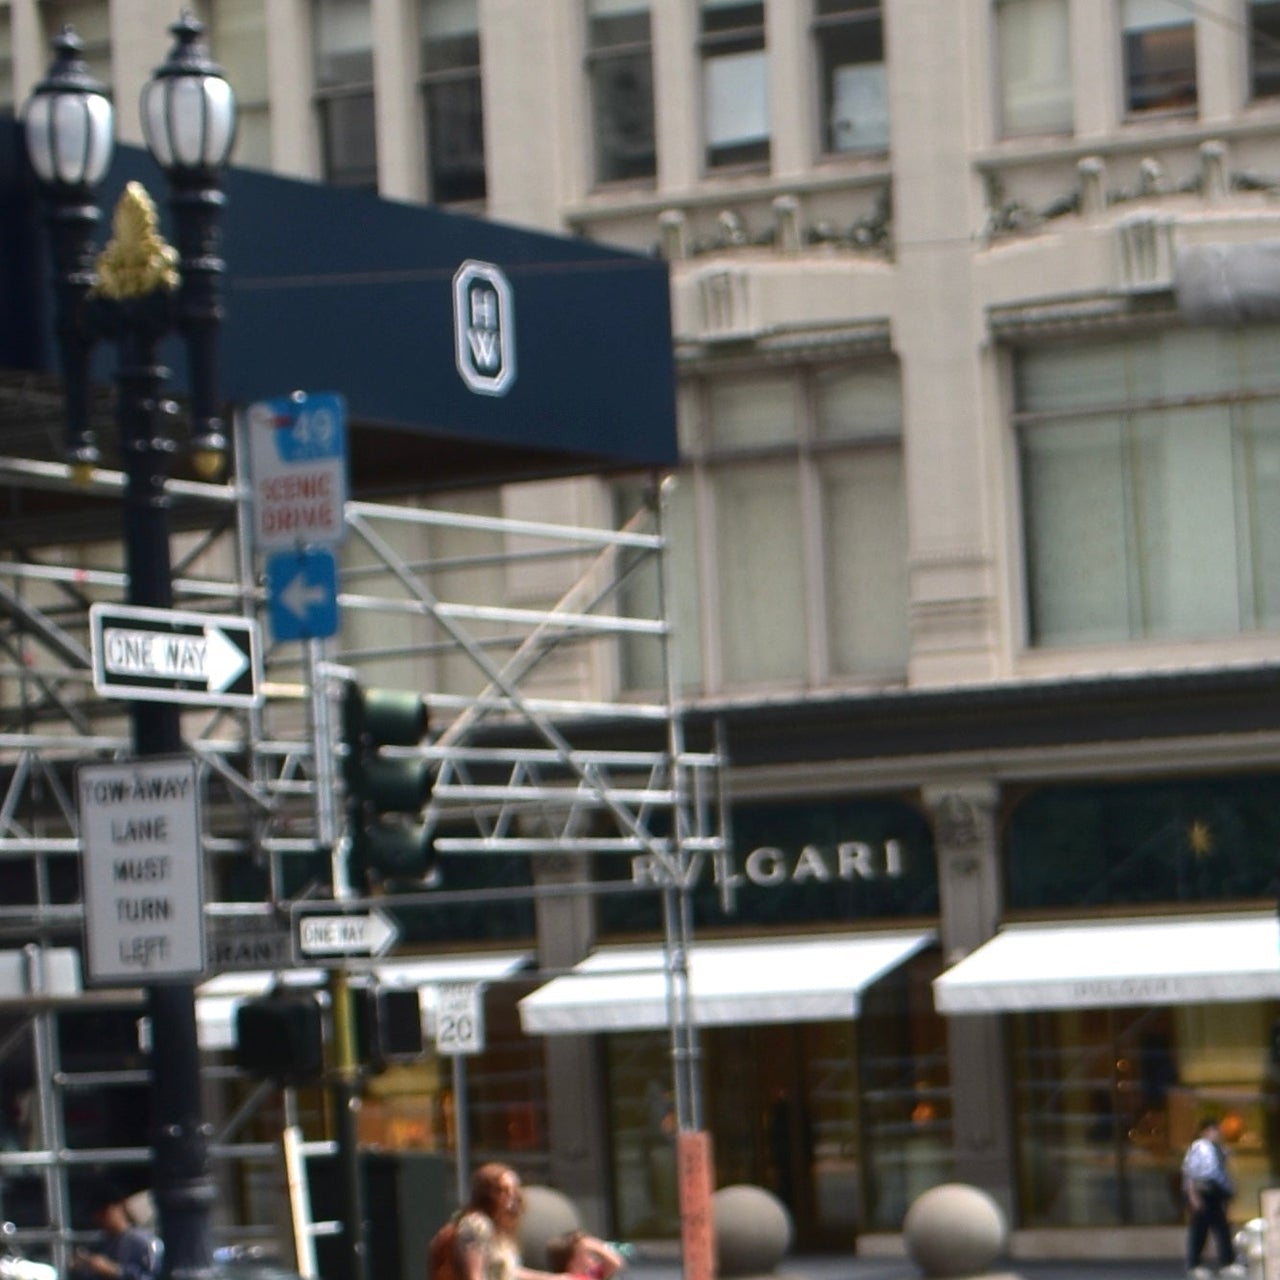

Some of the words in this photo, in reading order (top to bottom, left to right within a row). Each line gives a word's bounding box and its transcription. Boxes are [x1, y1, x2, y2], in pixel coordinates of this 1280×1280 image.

[293, 409, 334, 443] 49
[262, 473, 334, 500] SCENIC
[262, 506, 334, 533] DRIVE
[108, 636, 157, 668] ONE
[165, 638, 208, 670] WAY
[81, 777, 190, 805] TOW-AWAY
[110, 816, 169, 843] LANE
[112, 856, 170, 882] MUST
[115, 898, 172, 922] TURN
[303, 925, 333, 942] ONE
[339, 925, 366, 942] WAY
[117, 936, 170, 965] LEFT
[440, 1016, 473, 1043] 20
